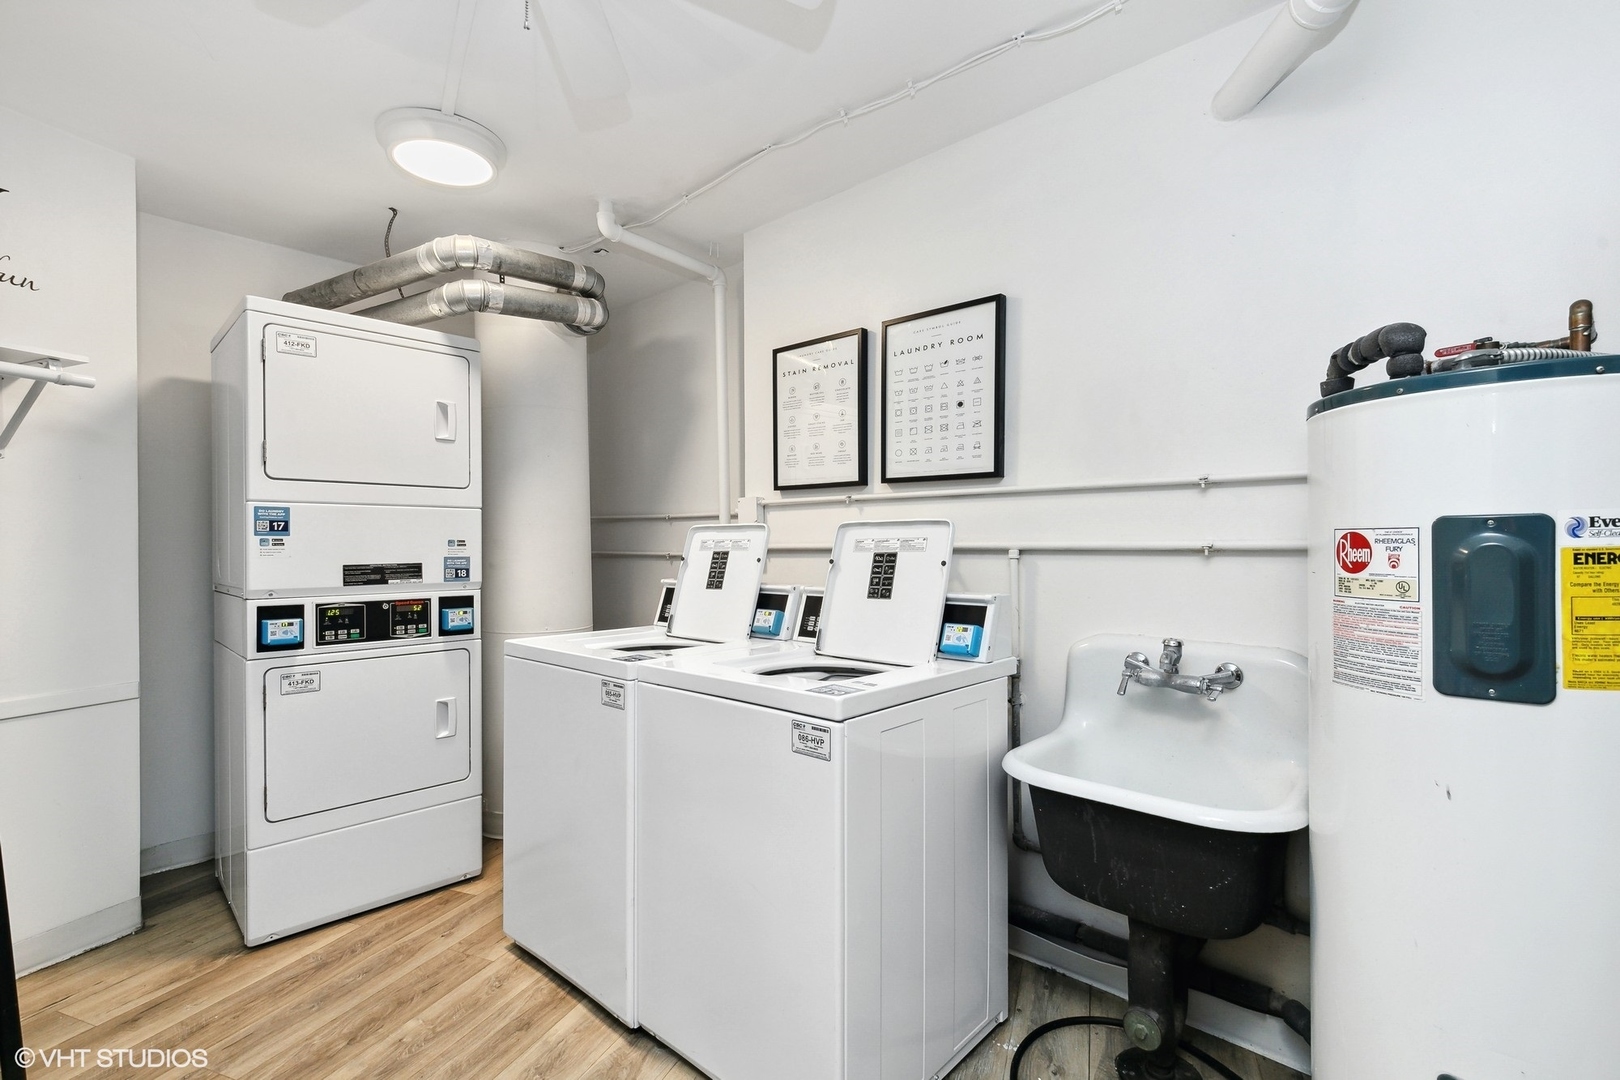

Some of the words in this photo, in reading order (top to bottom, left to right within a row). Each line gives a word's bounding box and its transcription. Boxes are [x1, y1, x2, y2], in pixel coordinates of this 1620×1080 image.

[0, 255, 40, 291] un
[283, 340, 311, 349] 412-FKD
[893, 341, 942, 357] LAUNDRY
[950, 333, 984, 346] ROOM
[782, 368, 807, 378] STAIN
[812, 359, 854, 372] REMOVAL
[272, 521, 285, 531] 17
[1374, 537, 1416, 545] RHEEMGLAS
[1340, 533, 1371, 569] Rheem
[1573, 552, 1620, 565] ENER
[457, 569, 467, 577] 18
[797, 733, 825, 746] 086-HVP
